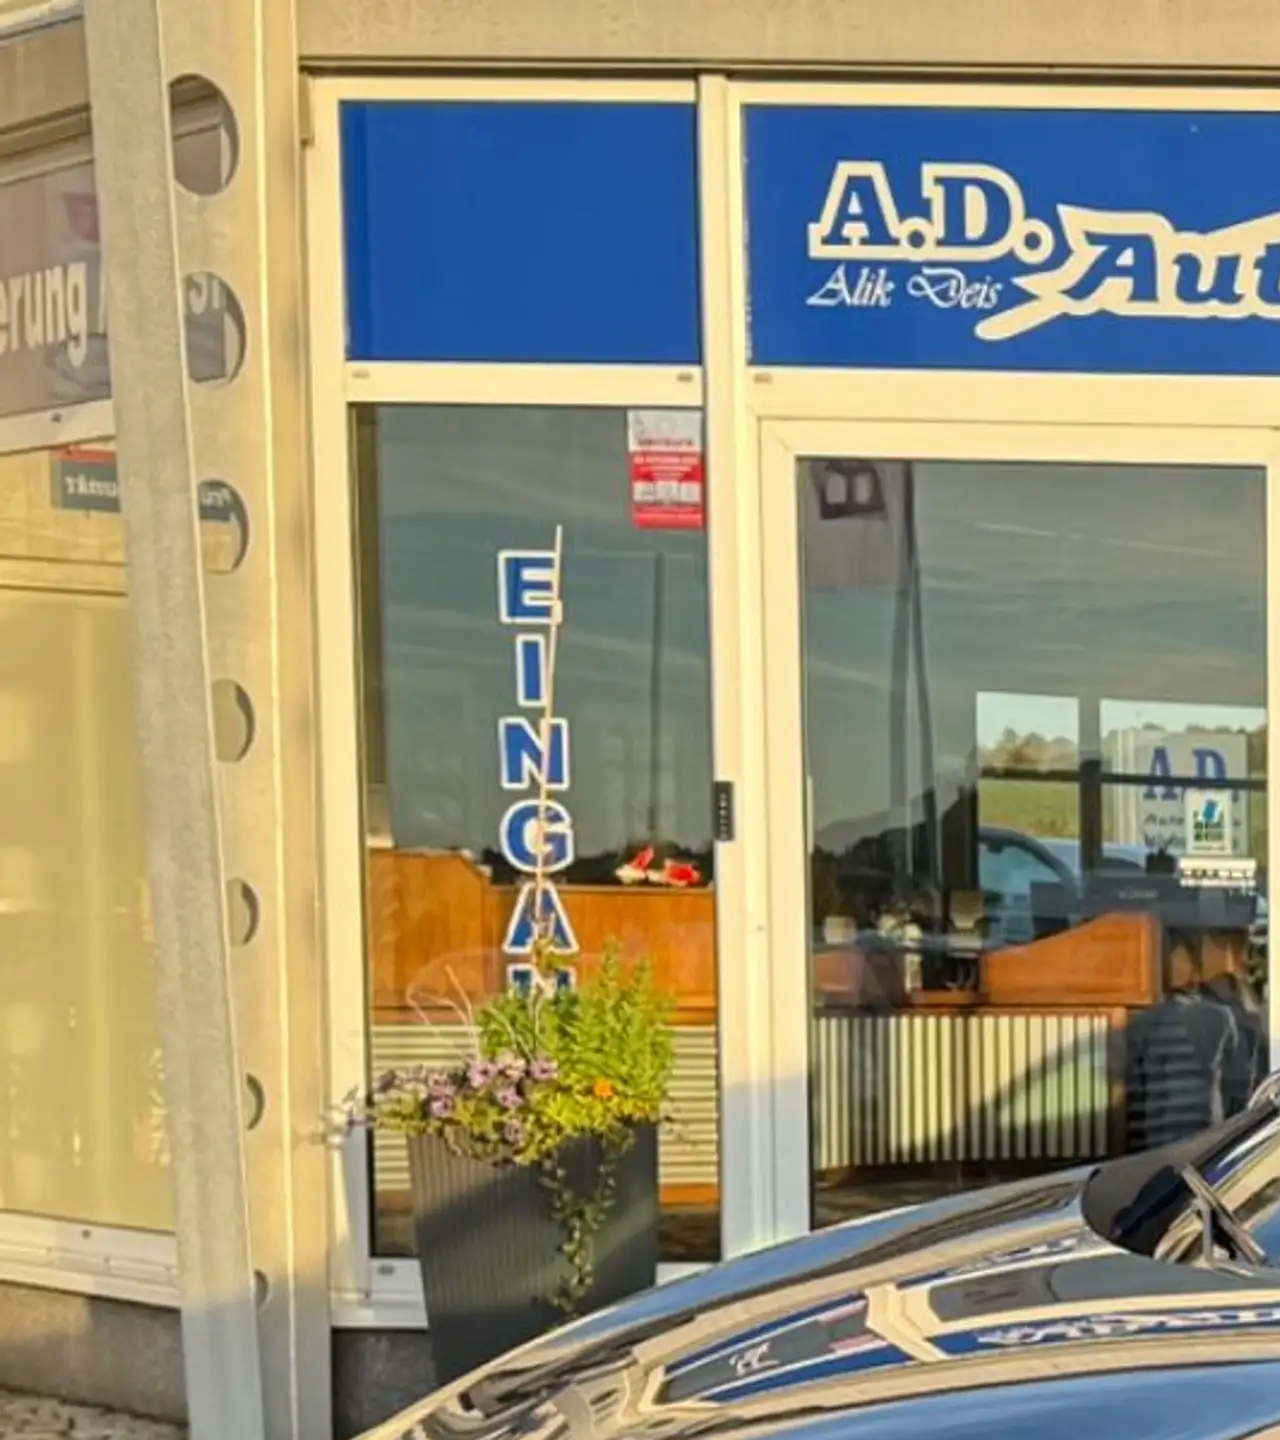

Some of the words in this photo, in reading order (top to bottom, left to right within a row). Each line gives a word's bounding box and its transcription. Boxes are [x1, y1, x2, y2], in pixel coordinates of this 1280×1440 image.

[808, 161, 1054, 264] A.D.
[806, 263, 894, 310] Alik
[906, 266, 1003, 310] Deis
